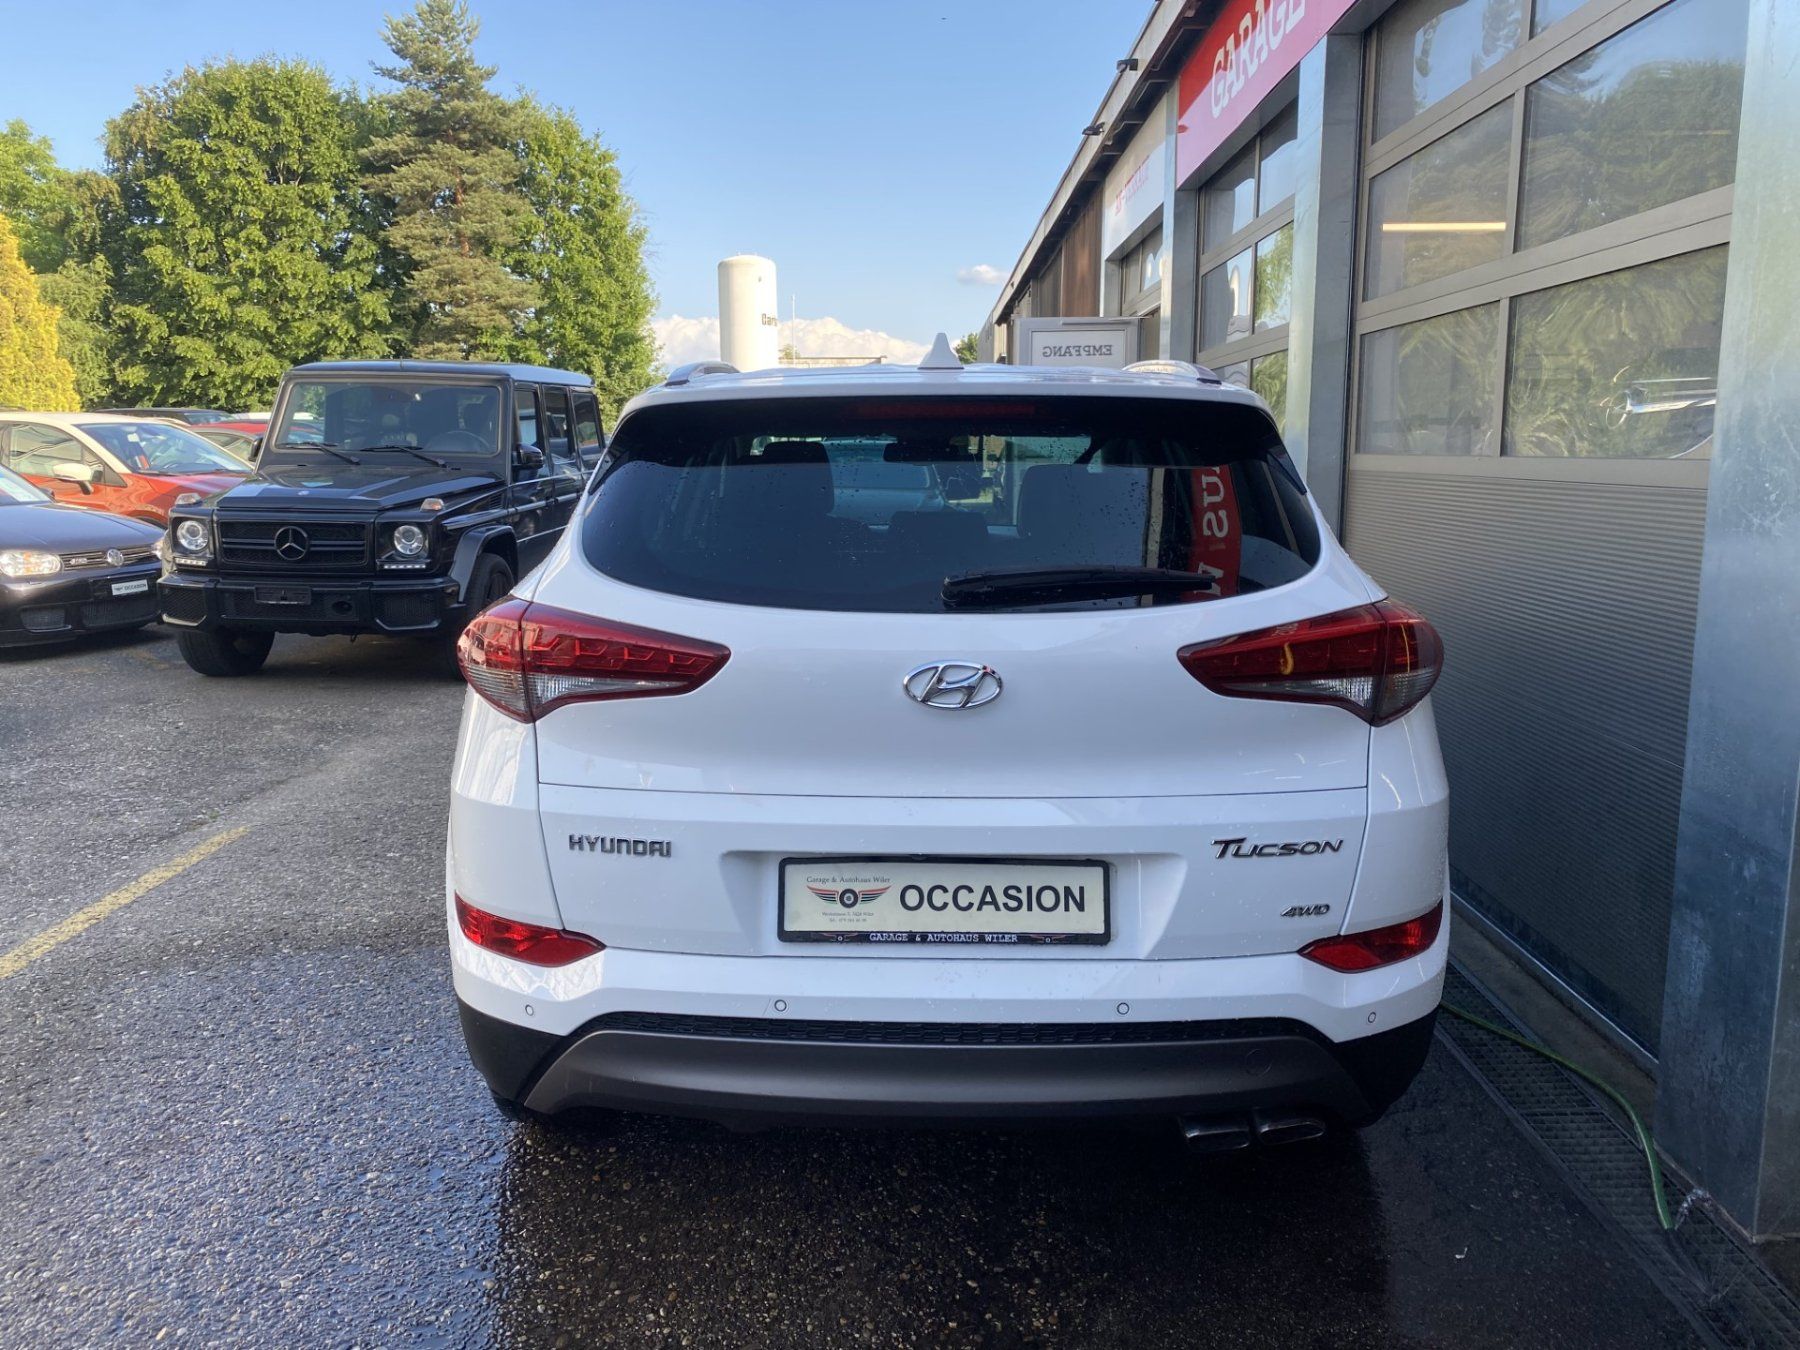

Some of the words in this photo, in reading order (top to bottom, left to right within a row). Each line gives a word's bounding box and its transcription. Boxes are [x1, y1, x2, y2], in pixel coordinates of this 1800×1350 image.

[569, 834, 672, 858] HYUNDAI
[1211, 837, 1344, 859] TUCSON
[806, 876, 829, 885] Garage
[899, 884, 1085, 913] OCCASION
[1280, 903, 1331, 917] 4WD
[869, 933, 908, 942] GARAGE
[915, 933, 921, 941] &
[927, 933, 979, 942] AUTOHAUS
[985, 934, 1018, 943] WILER
